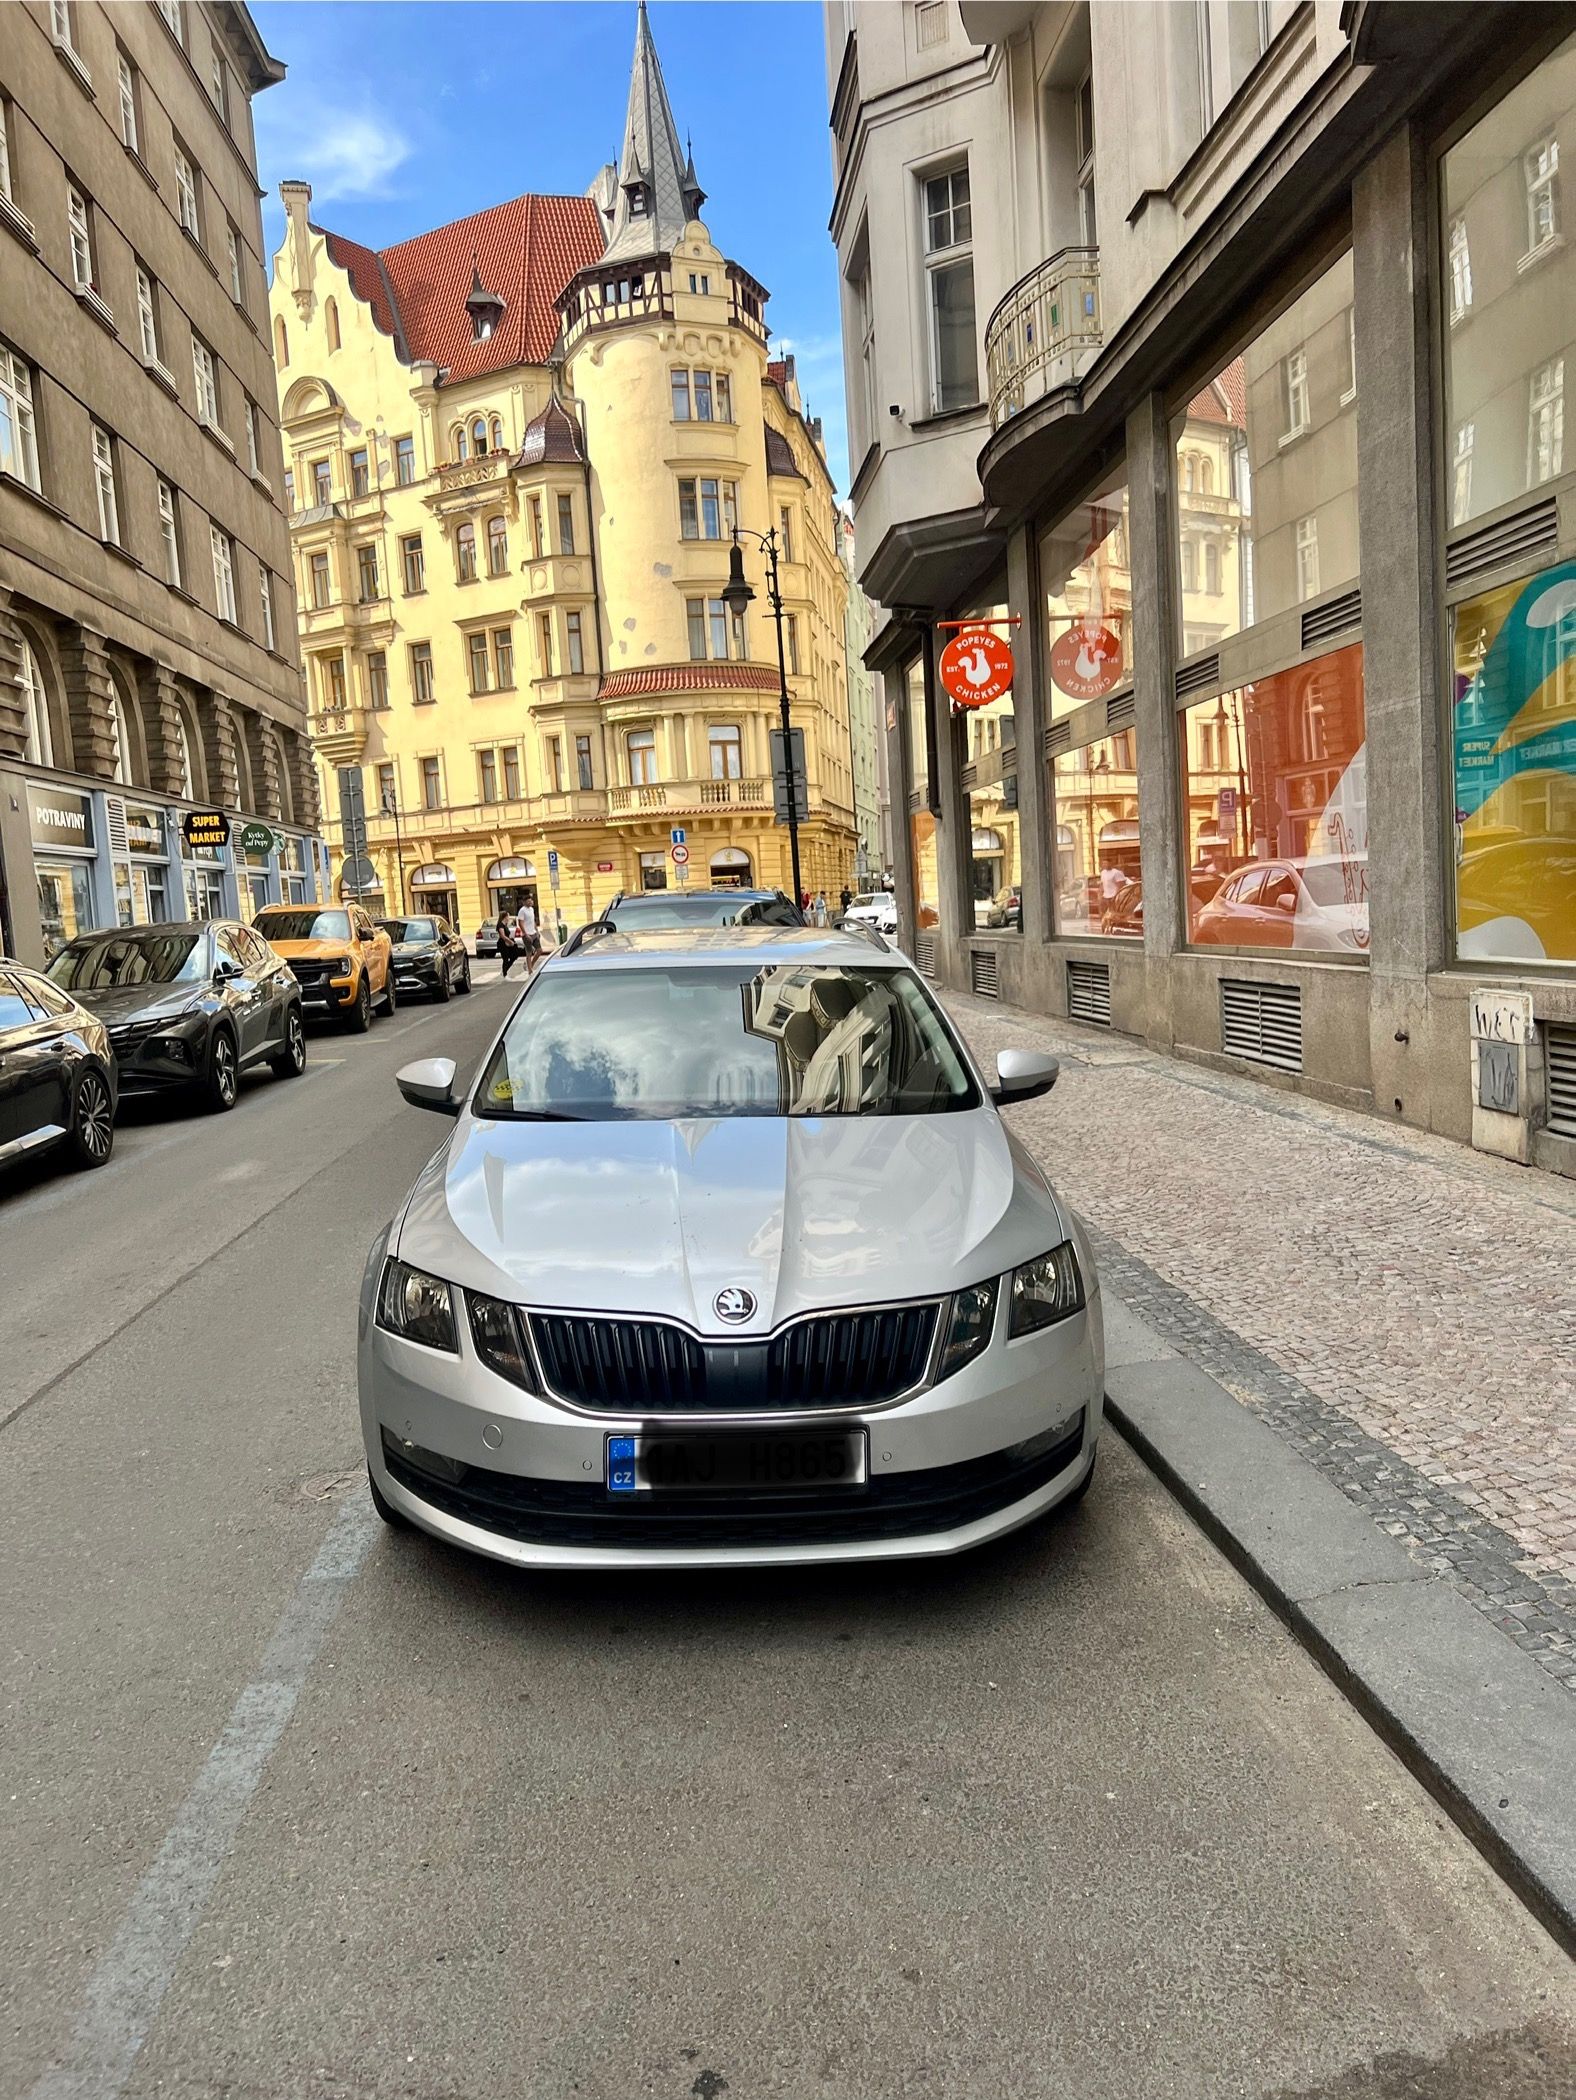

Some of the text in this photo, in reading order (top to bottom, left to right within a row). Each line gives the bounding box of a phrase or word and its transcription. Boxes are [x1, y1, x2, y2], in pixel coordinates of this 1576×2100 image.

[956, 636, 995, 650] POPEYES
[946, 665, 960, 673] EST.
[955, 683, 1001, 700] CHICKEN
[36, 806, 86, 830] POTRAVINY
[192, 816, 220, 827] SUPER
[189, 831, 226, 844] MARKET
[613, 1471, 632, 1484] CZ
